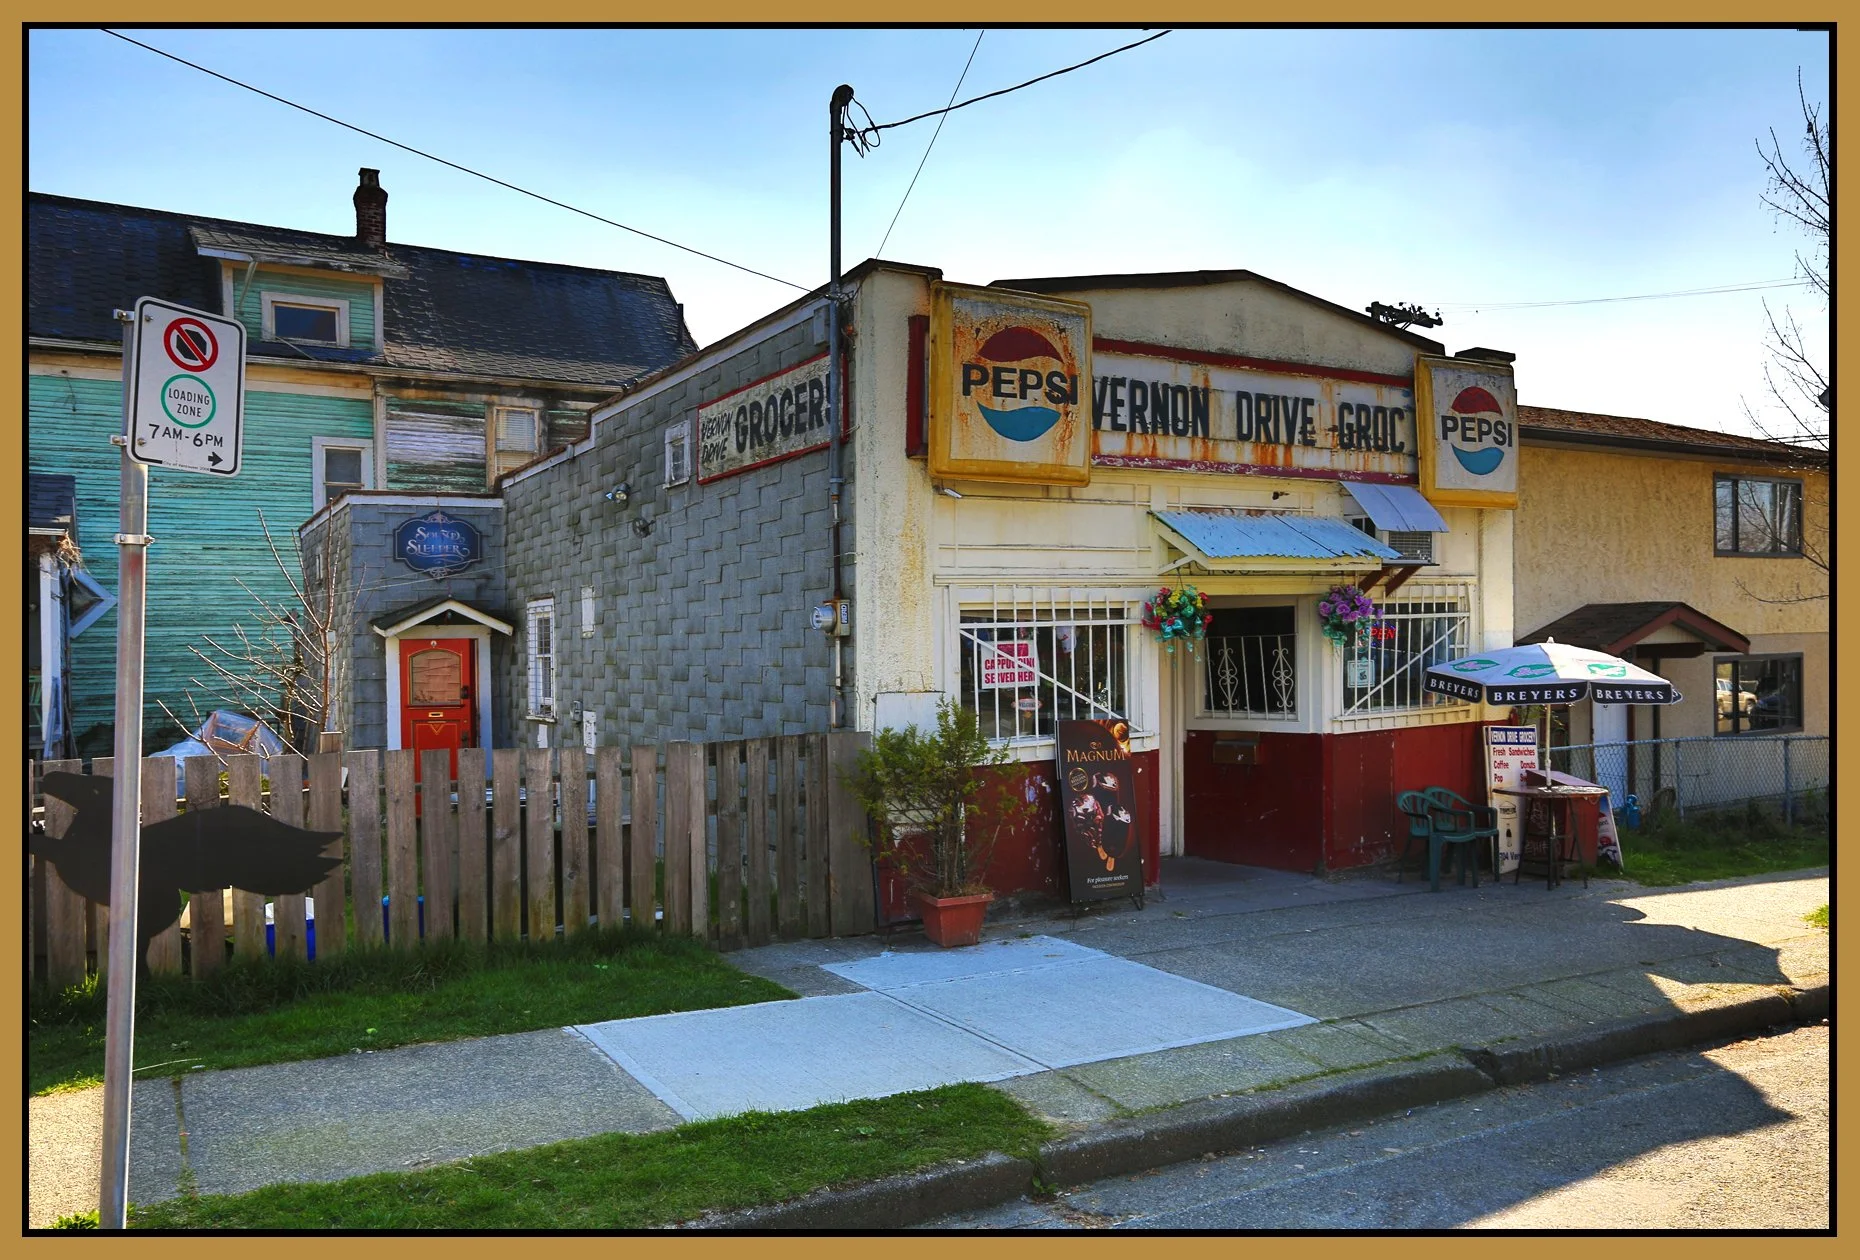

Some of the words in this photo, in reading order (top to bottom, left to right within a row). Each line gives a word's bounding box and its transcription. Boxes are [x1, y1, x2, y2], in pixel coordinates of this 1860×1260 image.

[962, 363, 1078, 405] PEPSI
[168, 388, 210, 405] LOADING
[177, 403, 202, 417] ZONE
[735, 371, 831, 453] GROCER
[1092, 376, 1210, 437] VERNON
[1236, 391, 1316, 447] DRIVE
[1338, 402, 1405, 452] GROC
[701, 411, 733, 442] VERNON
[1441, 415, 1512, 447] PEPSI
[701, 437, 728, 465] DRIVE
[1359, 627, 1397, 640] PEN
[1430, 678, 1480, 699] BREYERS
[1494, 688, 1578, 701] BREYERS
[1596, 689, 1664, 700] BREYERS
[1491, 730, 1506, 743] VERNON
[1506, 731, 1518, 743] DRIVE
[1067, 749, 1125, 762] MAGNUM
[1493, 747, 1506, 756] Fresh
[1508, 747, 1535, 756] Sandwiches
[1494, 760, 1509, 769] Coffee
[1520, 760, 1536, 769] Donuts
[1494, 773, 1504, 783] Pop
